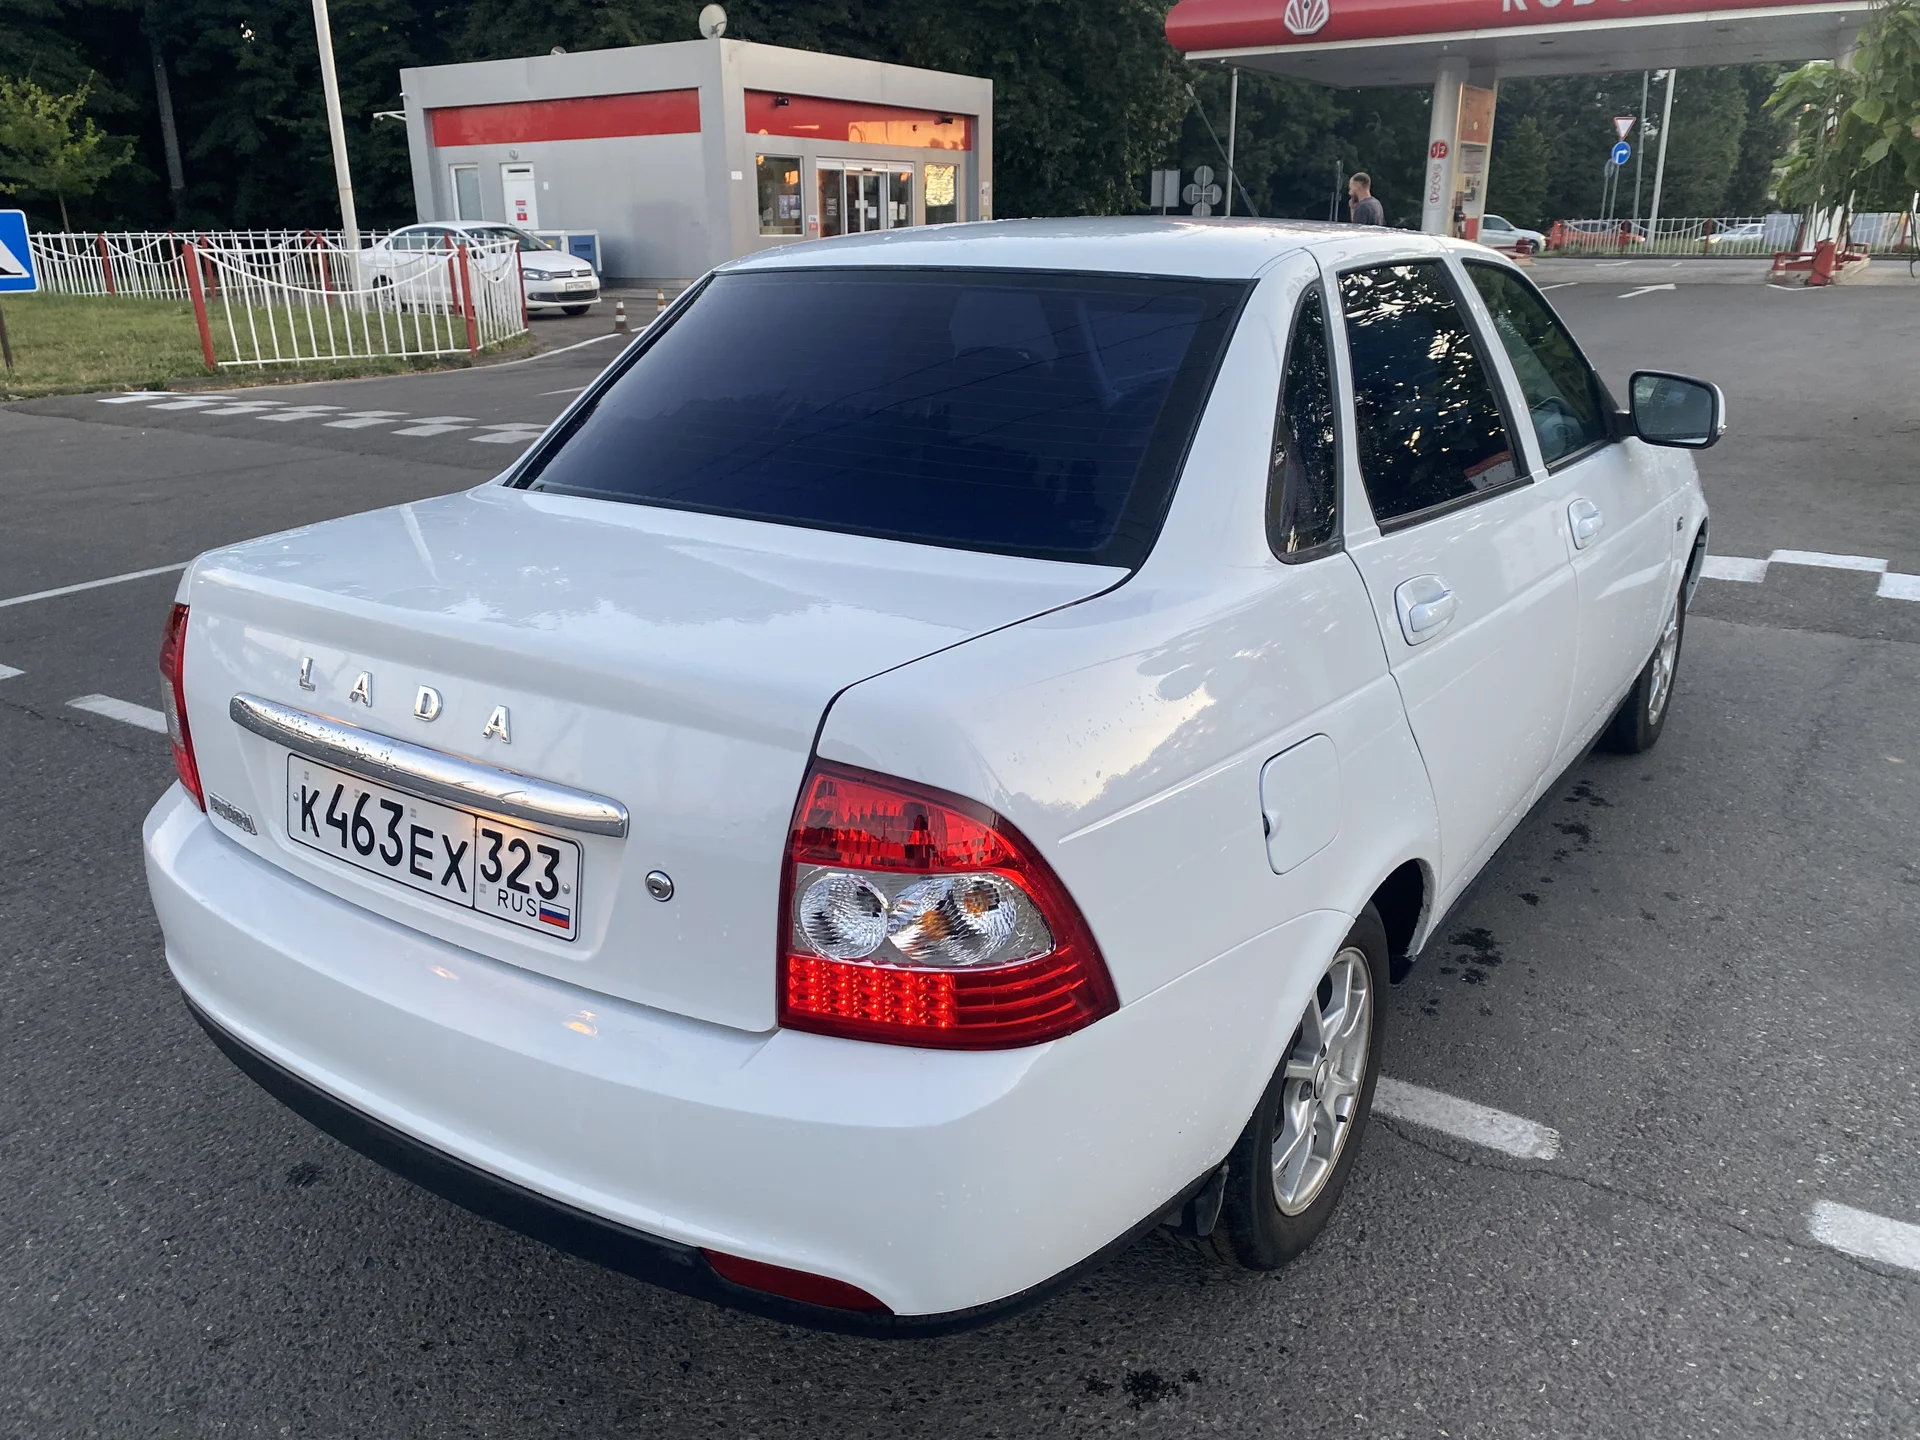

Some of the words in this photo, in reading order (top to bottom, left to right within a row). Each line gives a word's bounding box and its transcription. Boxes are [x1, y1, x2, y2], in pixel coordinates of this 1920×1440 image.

[299, 656, 512, 744] LADA
[301, 783, 468, 893] K463EX
[480, 827, 560, 900] 323
[497, 888, 537, 917] RUS
